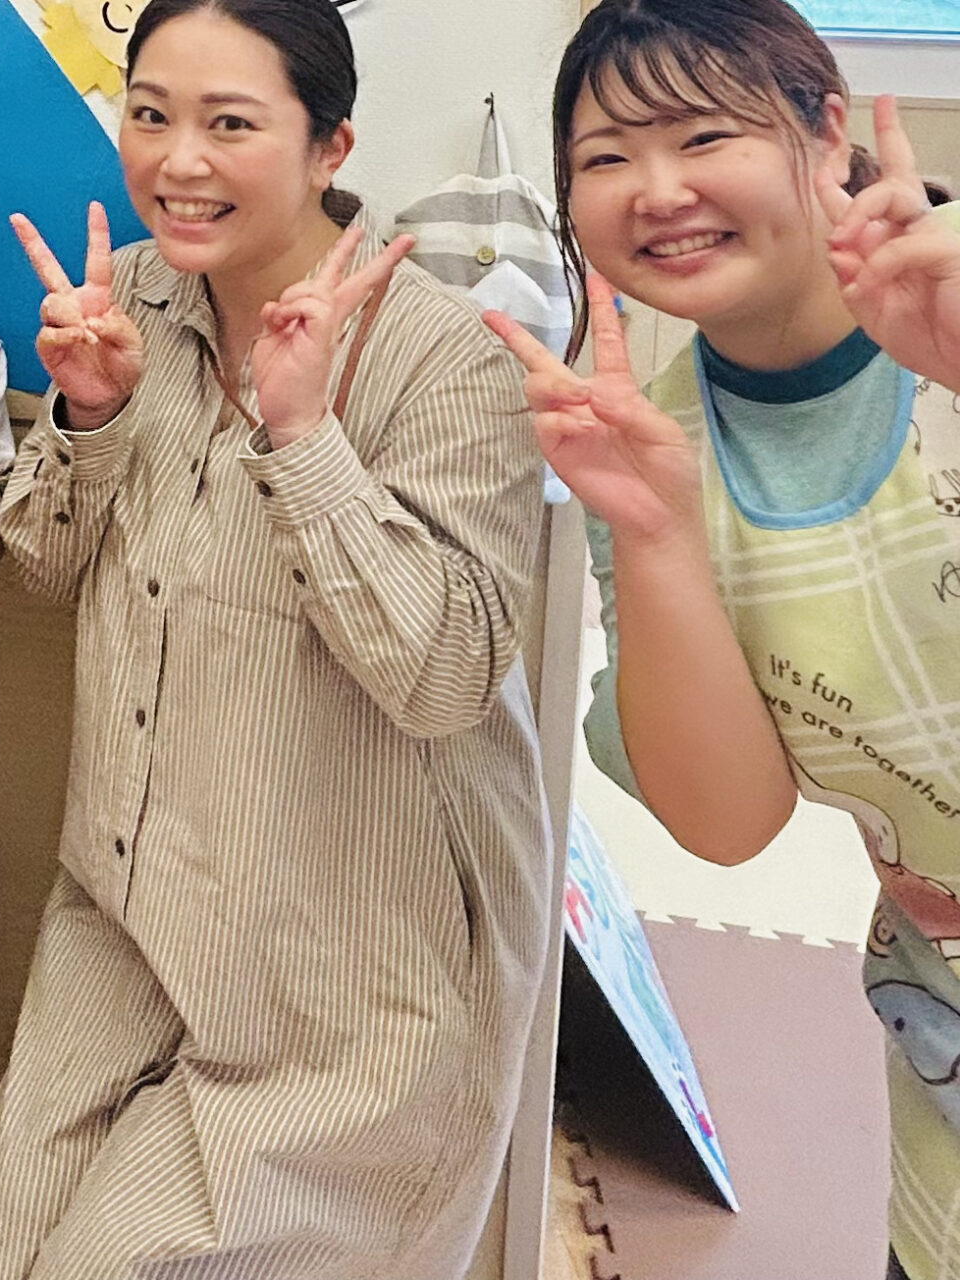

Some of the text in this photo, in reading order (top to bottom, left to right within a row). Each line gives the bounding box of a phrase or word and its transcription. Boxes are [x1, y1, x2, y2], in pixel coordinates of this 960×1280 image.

[770, 654, 853, 713] It's fun
[801, 711, 844, 739] are
